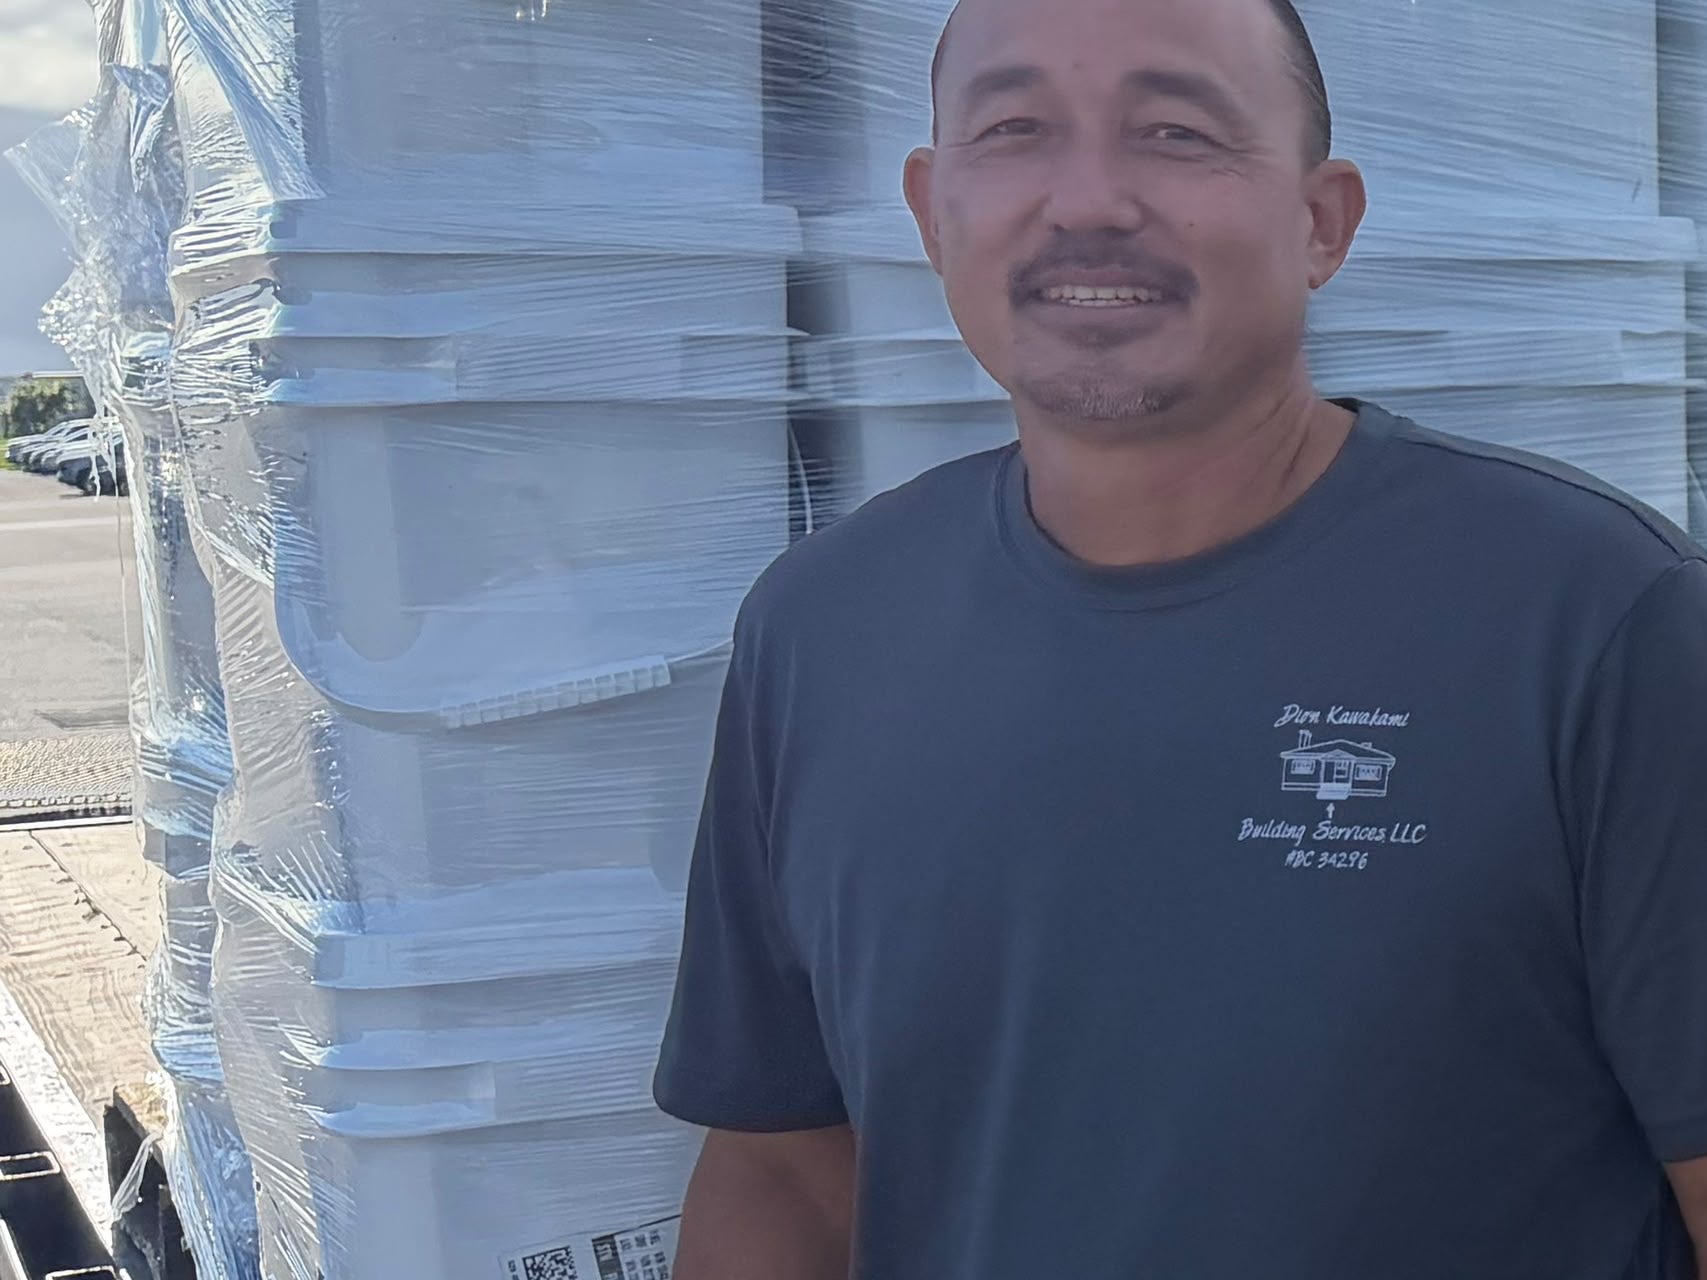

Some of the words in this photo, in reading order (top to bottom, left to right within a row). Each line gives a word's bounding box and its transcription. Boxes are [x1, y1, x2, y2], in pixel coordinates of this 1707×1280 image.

[1273, 703, 1321, 728] Dion
[1326, 705, 1410, 727] Kawakami
[1237, 817, 1306, 847] Building
[1390, 823, 1427, 844] LLC
[1318, 850, 1369, 870] 34296
